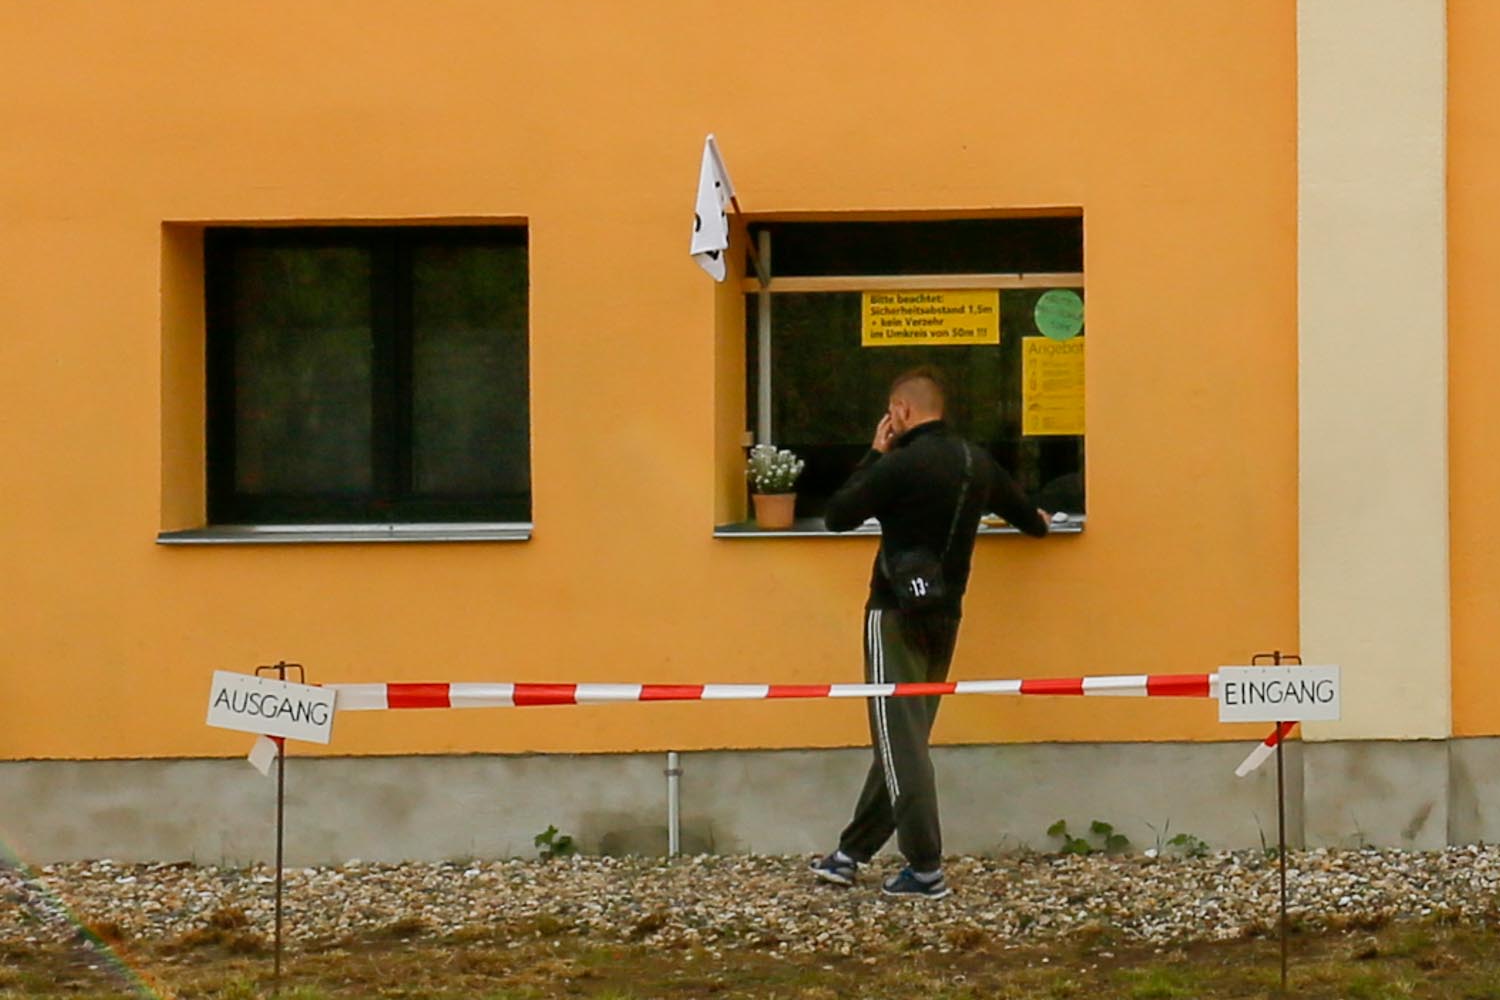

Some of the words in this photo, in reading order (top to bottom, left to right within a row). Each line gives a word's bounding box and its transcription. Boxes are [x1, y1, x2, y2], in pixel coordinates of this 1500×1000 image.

[870, 306, 966, 316] Sicherheitsabstand
[881, 317, 903, 327] kein
[905, 317, 945, 327] Verzehr
[870, 328, 884, 338] im
[886, 328, 928, 338] Umkreis
[930, 328, 950, 337] von
[1225, 680, 1335, 705] EINGANG
[214, 688, 329, 726] AUSGANG
